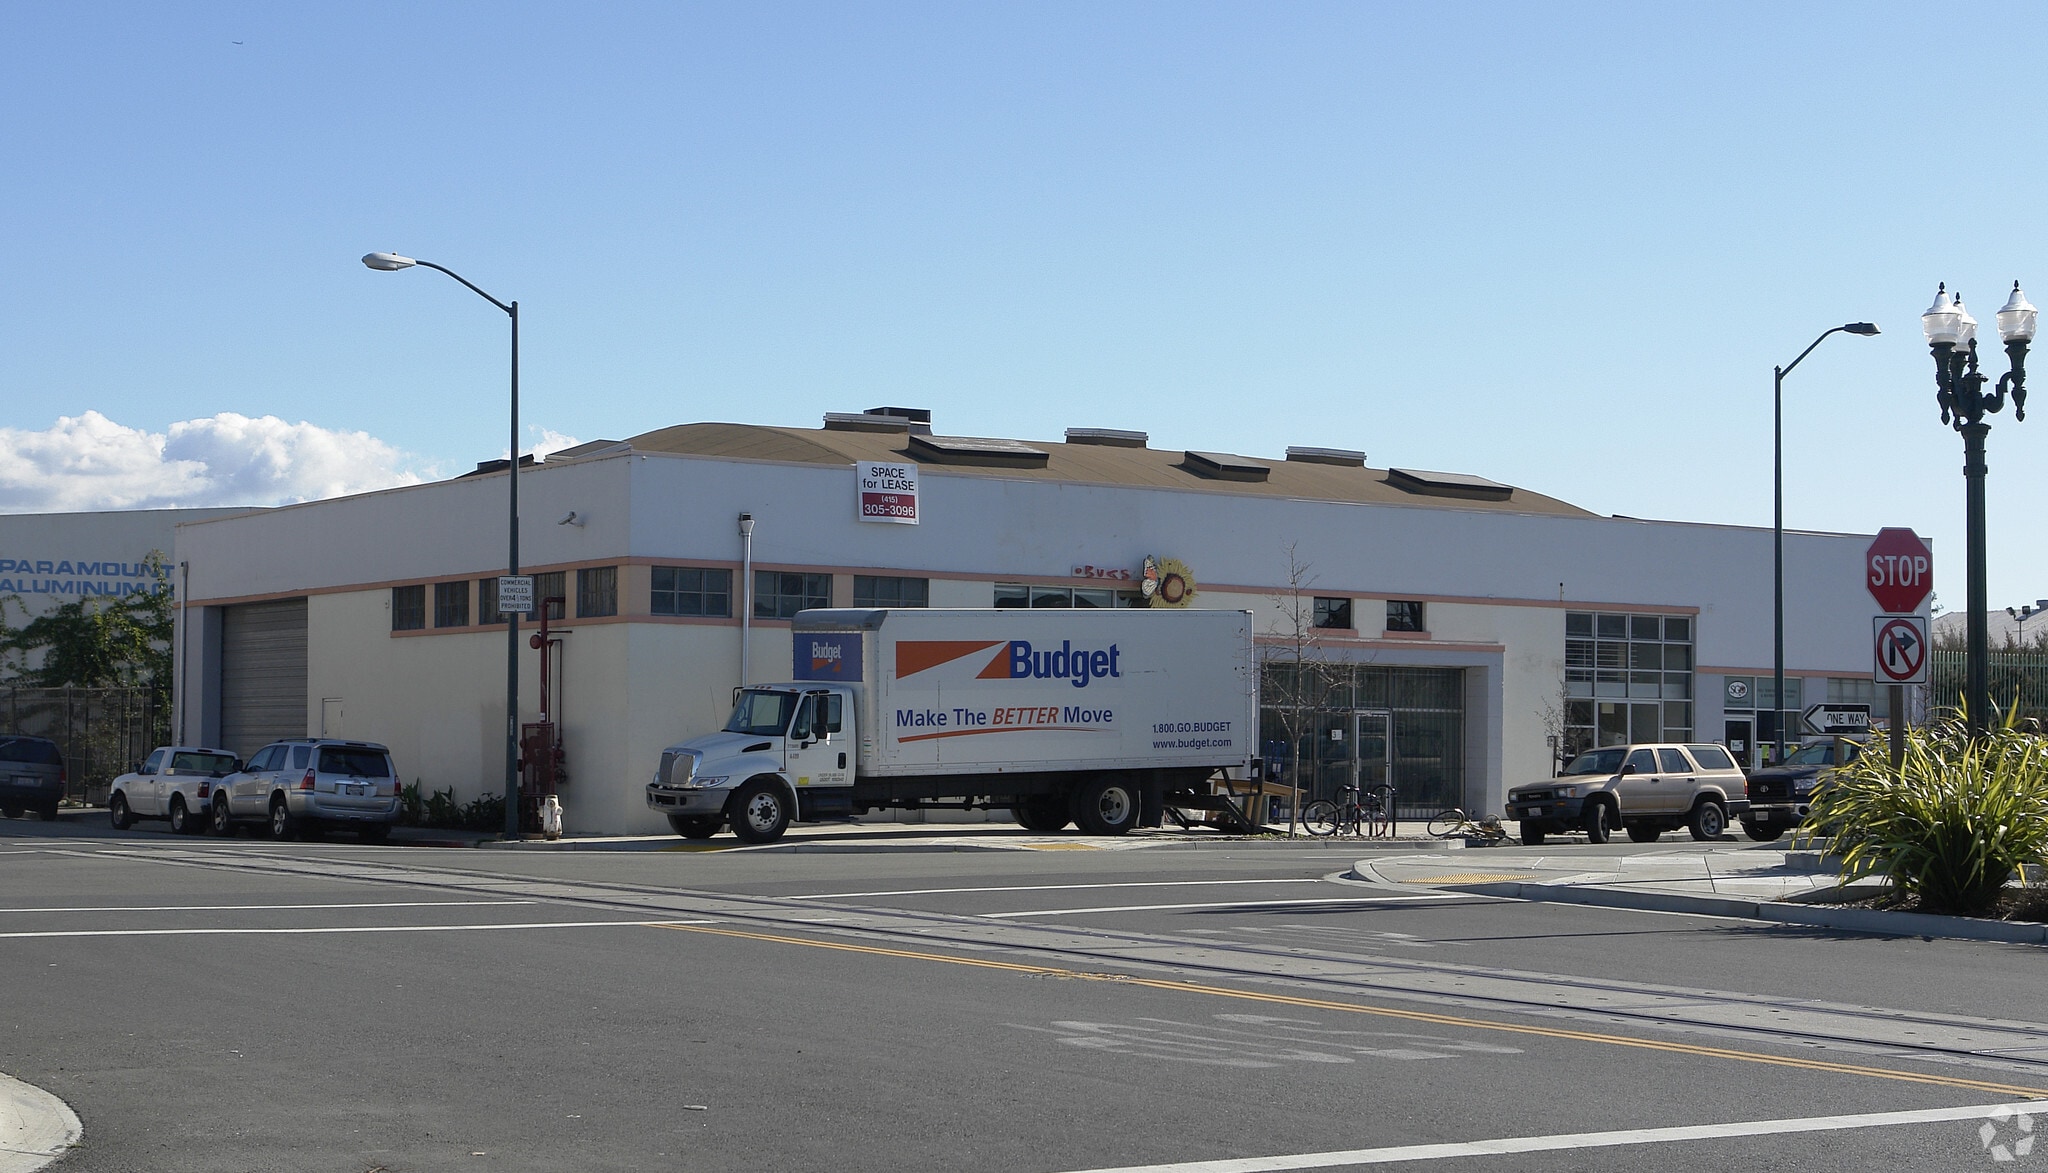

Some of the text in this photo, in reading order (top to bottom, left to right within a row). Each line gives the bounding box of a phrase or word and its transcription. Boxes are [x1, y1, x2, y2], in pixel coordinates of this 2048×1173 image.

[871, 466, 905, 479] SPACE
[863, 478, 915, 491] for LEASE
[881, 495, 898, 504] (415)
[864, 504, 915, 516] 305-3096
[0, 559, 175, 579] PARAMOUNT
[1871, 555, 1928, 587] STOP
[0, 579, 145, 596] ALUMINUM
[812, 641, 842, 663] Budget
[1009, 639, 1120, 689] Budget
[896, 706, 1113, 727] Make The BETTER Move
[1827, 713, 1865, 725] ONE WAY
[1152, 721, 1231, 734] 1.800.GO.BUDGET
[1152, 738, 1232, 750] www.budget.com
